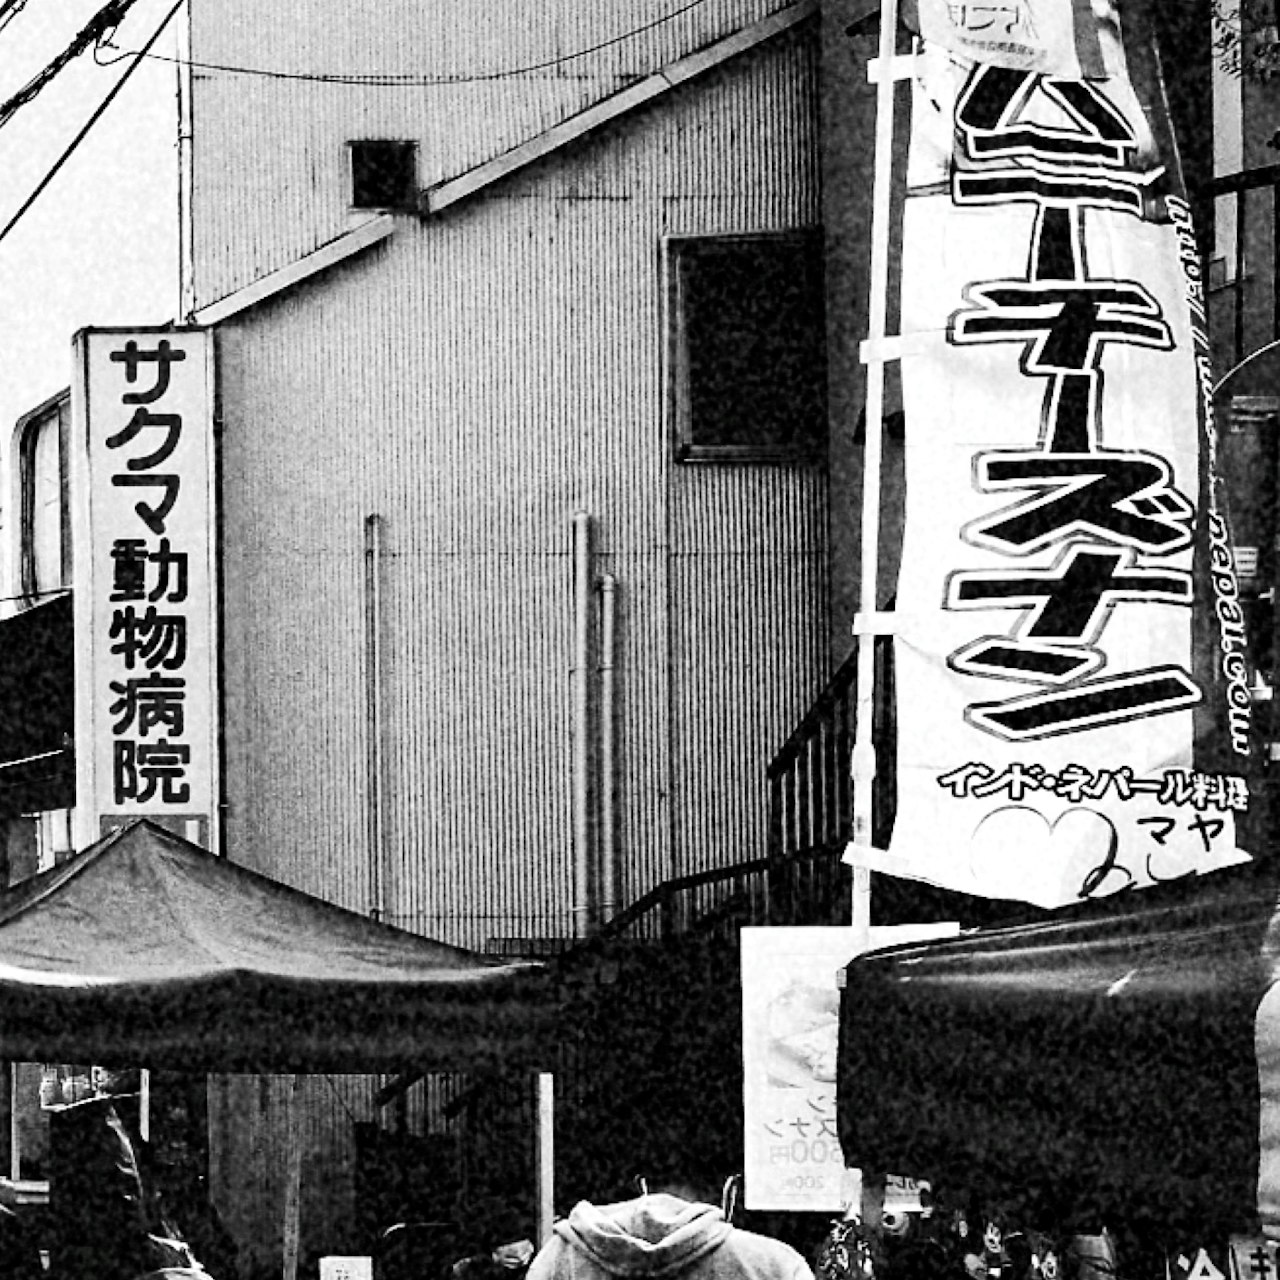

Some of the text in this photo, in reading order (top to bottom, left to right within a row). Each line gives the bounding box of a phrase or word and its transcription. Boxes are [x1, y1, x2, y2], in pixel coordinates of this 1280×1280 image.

[105, 340, 191, 804] サクマ動物病院
[936, 761, 1250, 812] インド・ネパール料理
[1136, 813, 1225, 852] マヤ
